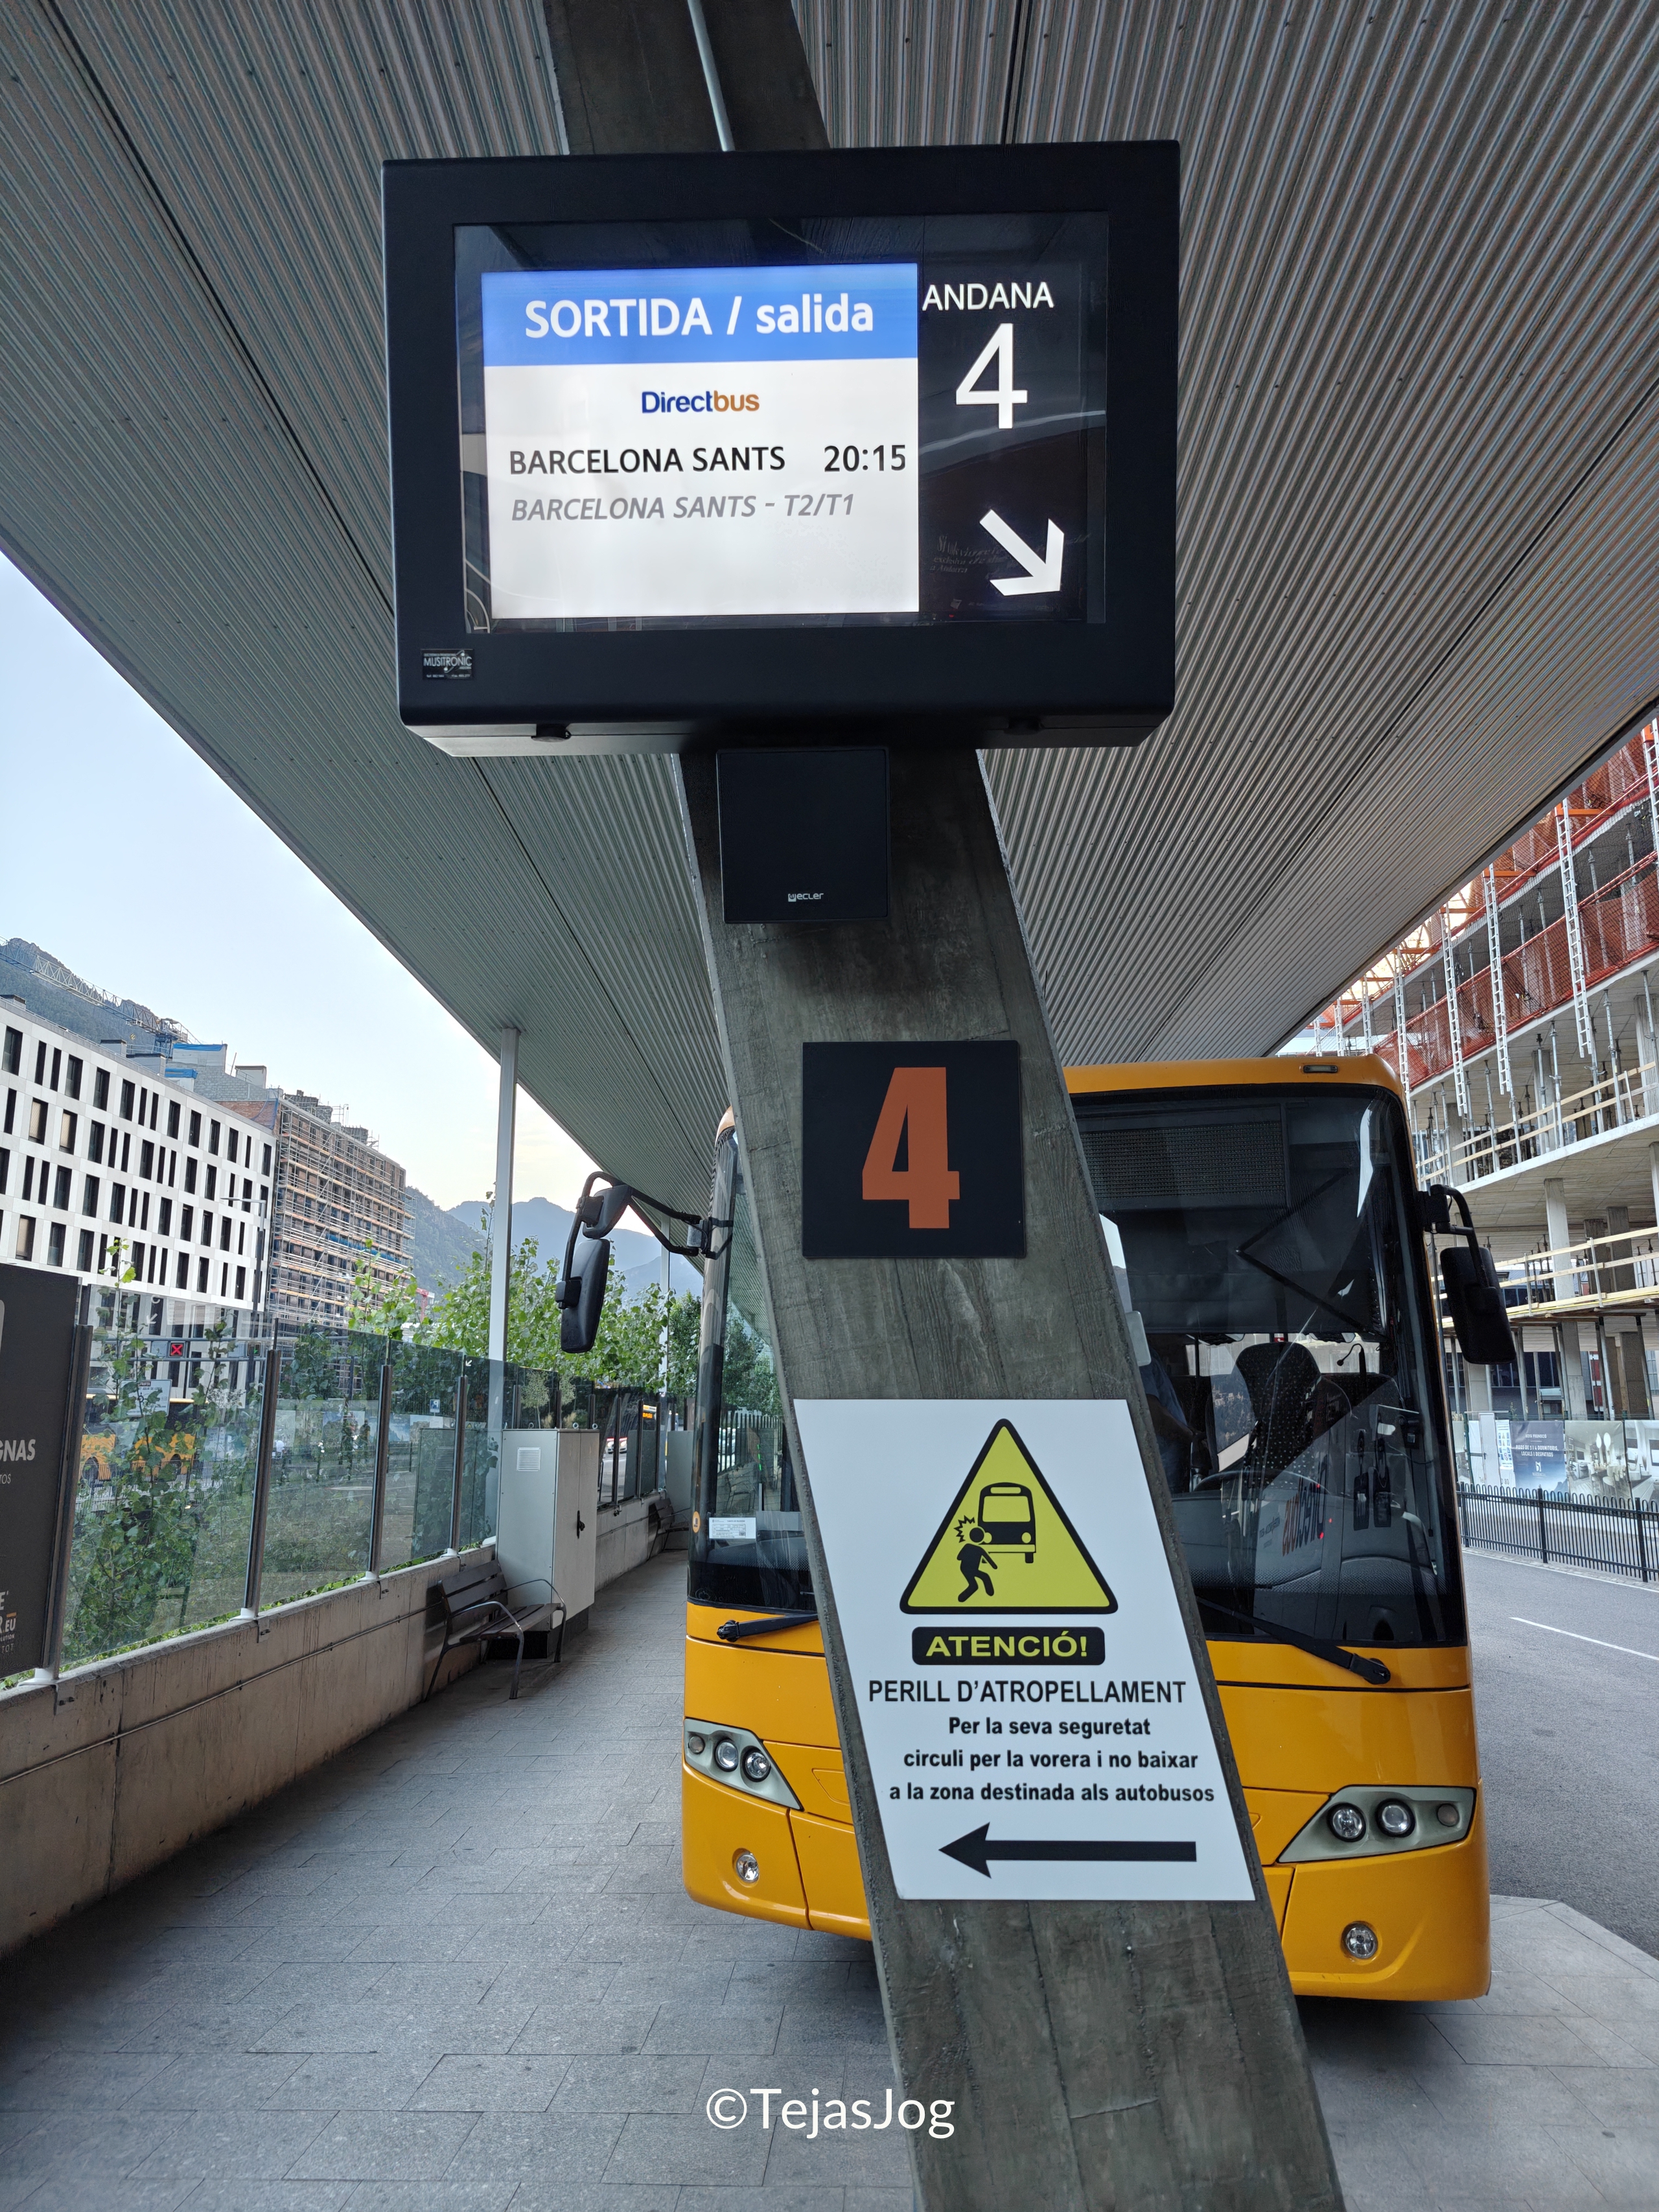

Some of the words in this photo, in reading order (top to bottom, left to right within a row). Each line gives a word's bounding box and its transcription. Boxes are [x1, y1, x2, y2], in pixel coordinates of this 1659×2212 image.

[922, 281, 1054, 311] ANDANA
[526, 297, 713, 338] SORTIDA
[726, 296, 742, 335] /
[756, 292, 874, 334] salida
[956, 323, 1028, 429] 4
[642, 390, 760, 413] Directbus
[510, 448, 684, 474] BARCELONA
[693, 446, 785, 472] SANTS
[824, 444, 906, 472] 20:15
[511, 497, 665, 521] BARCELONA
[673, 495, 757, 518] SANTS
[784, 493, 854, 517] T2/T1
[423, 657, 472, 666] MUSITRONIC
[862, 1067, 960, 1229] 4
[925, 1630, 1087, 1657] ATENCIÓ!
[869, 1680, 951, 1702] PERILL
[957, 1680, 1187, 1703] D’ATROPELLAMENT
[949, 1716, 980, 1734] Per
[986, 1717, 1003, 1734] la
[1009, 1721, 1052, 1734] seva
[1058, 1718, 1151, 1739] seguretat
[903, 1749, 963, 1767] circuli
[970, 1754, 1001, 1771] per
[1006, 1749, 1024, 1767] la
[1030, 1754, 1091, 1767] vorera
[1097, 1750, 1102, 1767] i
[1109, 1754, 1131, 1768] no
[1138, 1750, 1198, 1768] baixar
[889, 1786, 901, 1800] a
[907, 1782, 924, 1800] la
[930, 1786, 974, 1800] zona
[980, 1782, 1074, 1801] destinada
[1081, 1783, 1109, 1801] als
[1115, 1784, 1214, 1802] autobusos
